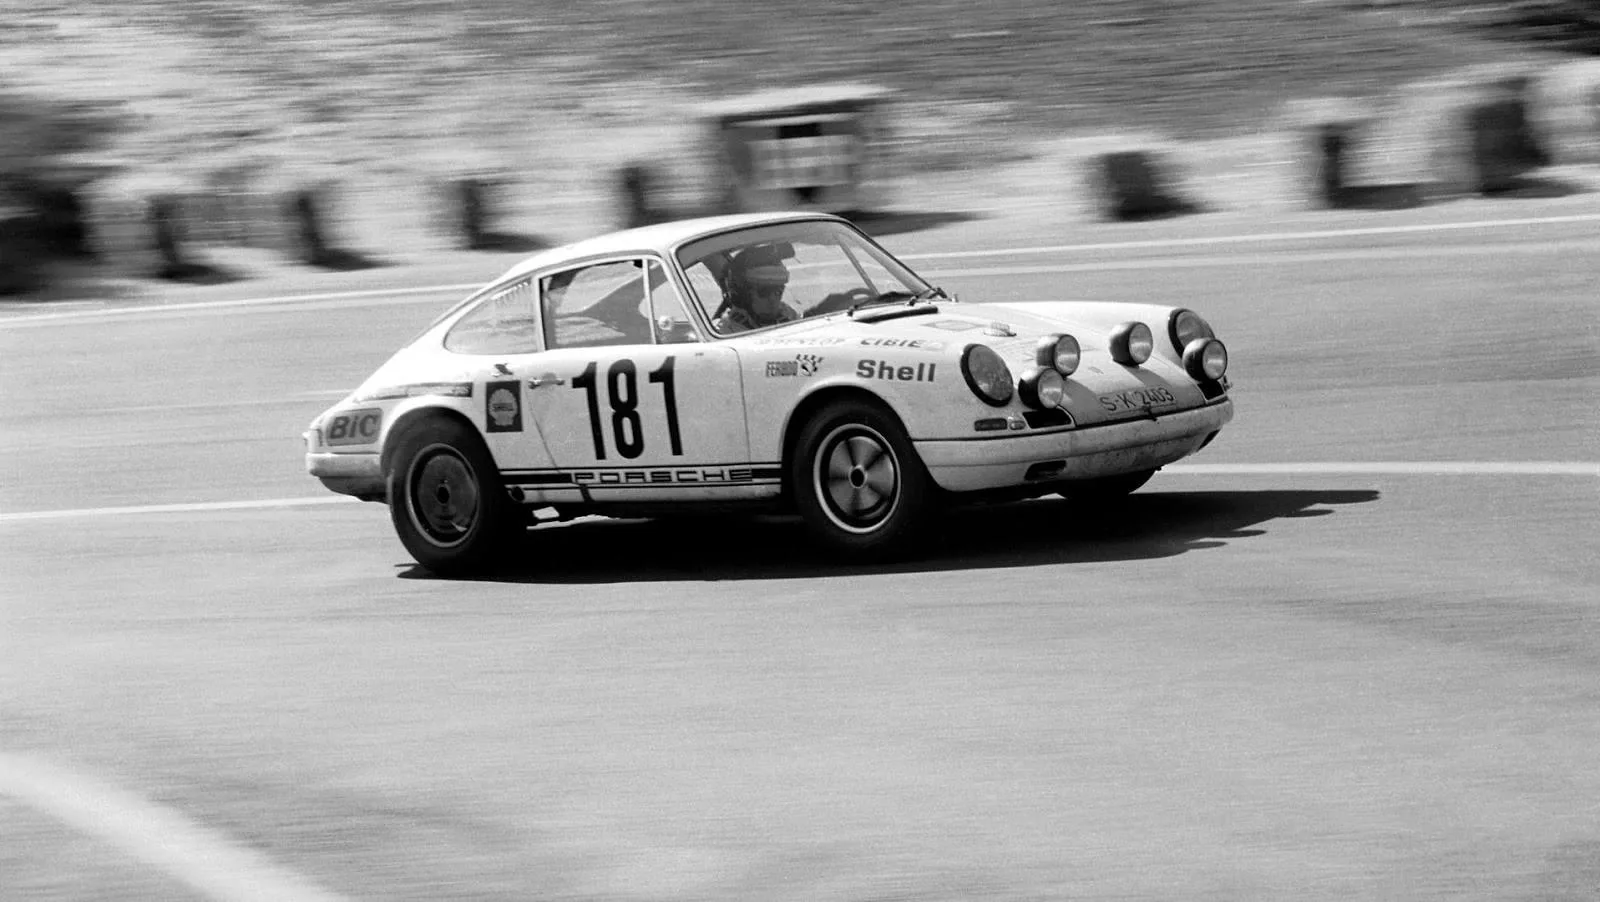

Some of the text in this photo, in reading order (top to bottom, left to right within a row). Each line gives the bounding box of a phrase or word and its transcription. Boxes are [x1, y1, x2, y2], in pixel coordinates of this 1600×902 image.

[856, 359, 936, 382] Shell
[571, 355, 683, 460] 181
[573, 468, 752, 484] PORSCHE
